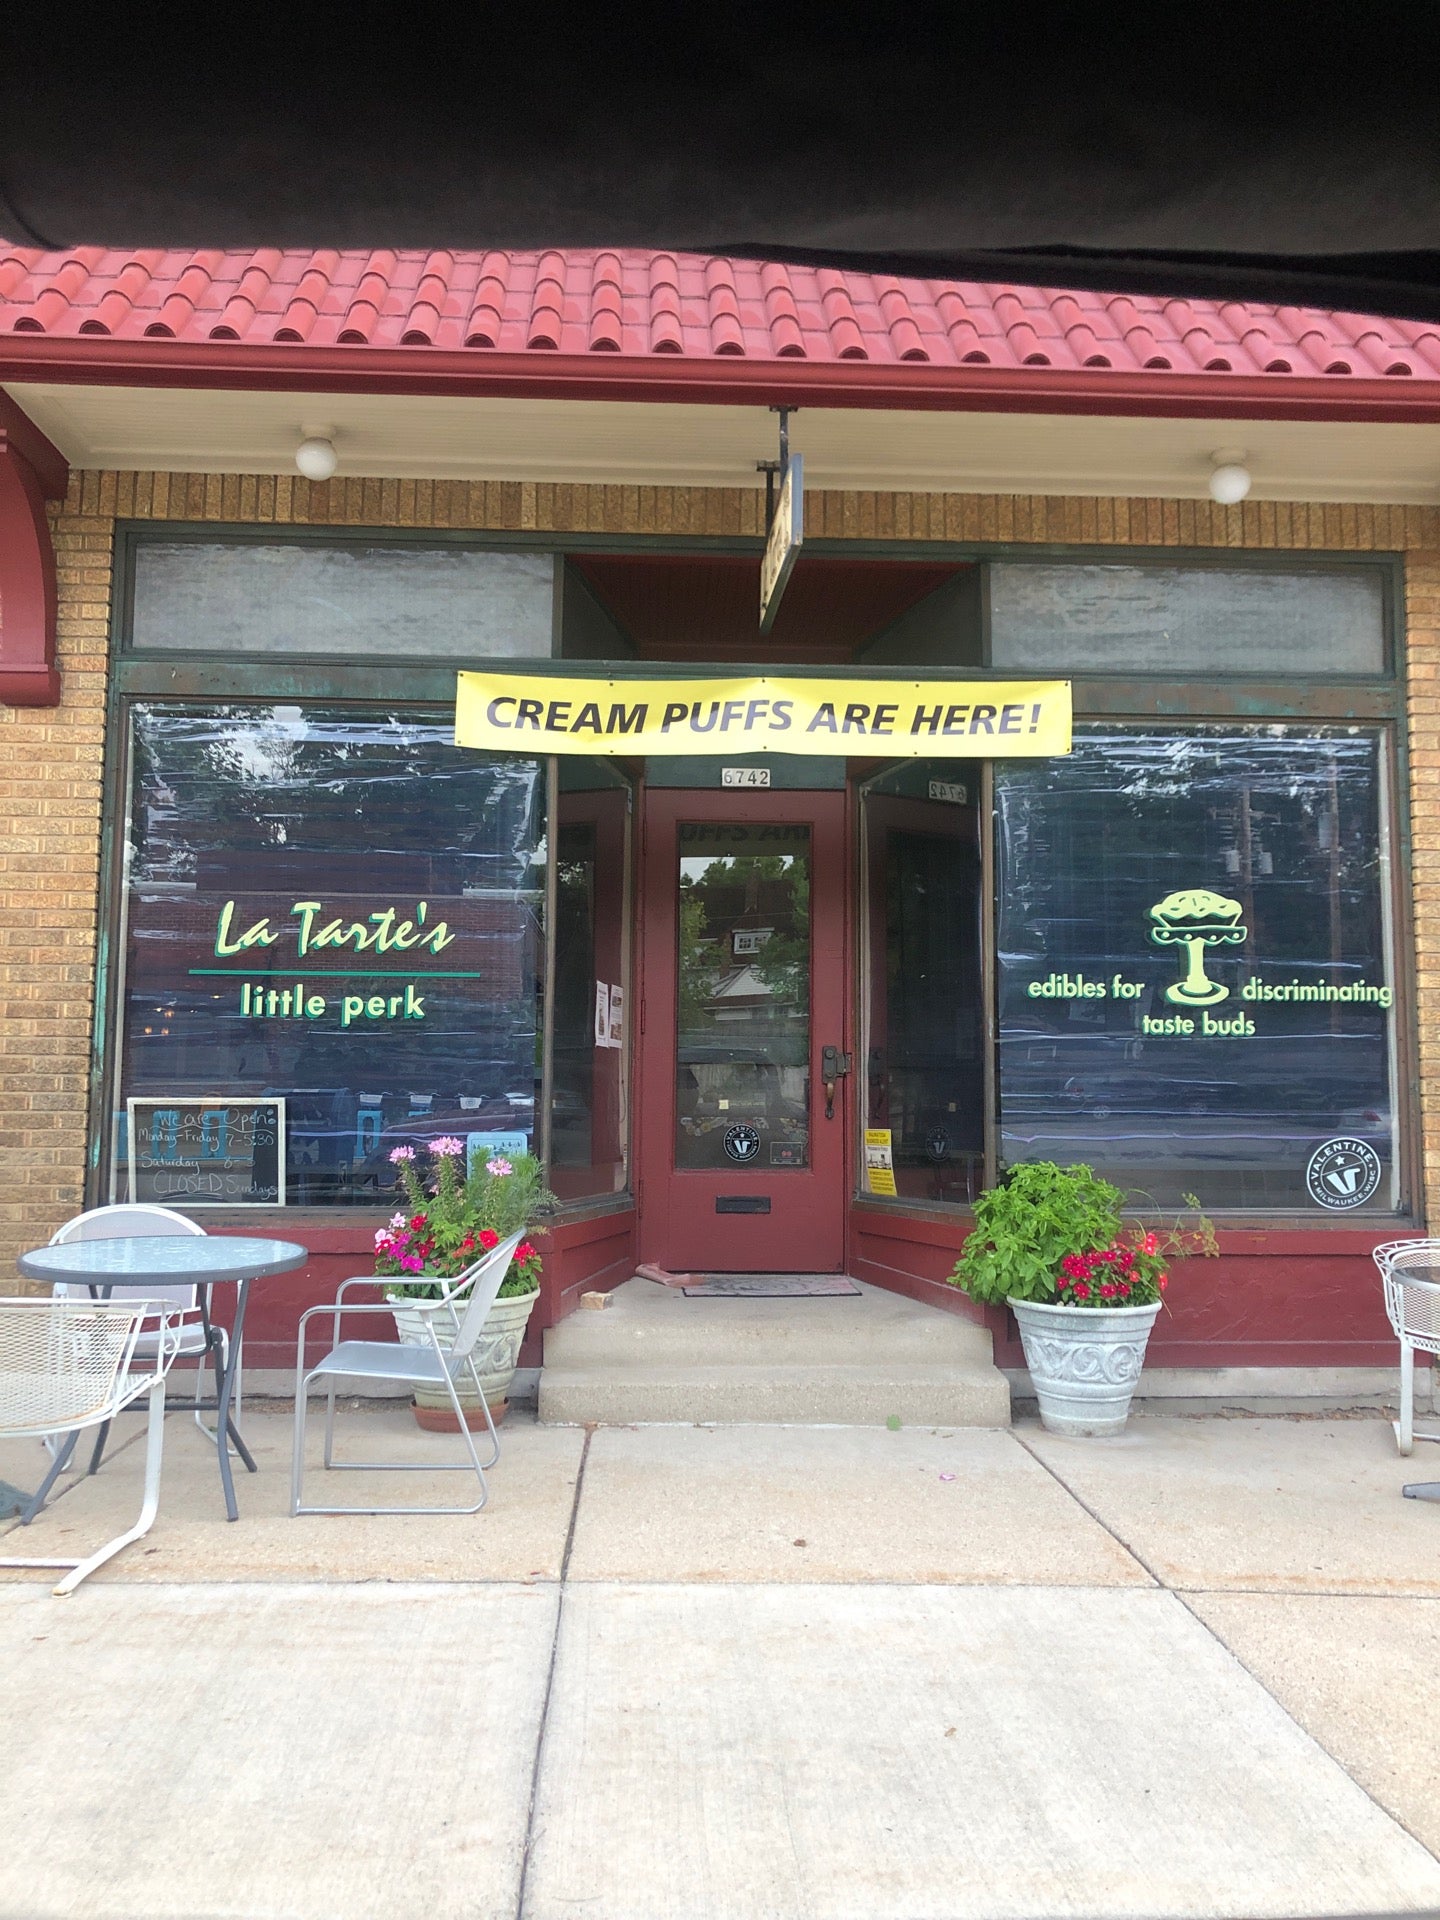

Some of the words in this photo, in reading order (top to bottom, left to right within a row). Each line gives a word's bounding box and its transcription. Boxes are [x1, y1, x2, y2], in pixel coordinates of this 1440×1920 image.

[485, 696, 648, 735] CREAM
[661, 699, 794, 735] PUFFS
[806, 703, 899, 736] ARE
[910, 703, 1042, 736] HERE!
[723, 769, 769, 786] 6742
[214, 900, 279, 957] La
[290, 901, 456, 957] Tarte's
[240, 982, 326, 1018] little
[341, 984, 425, 1027] perk
[1027, 973, 1106, 999] edibles
[1112, 974, 1145, 999] for
[1242, 976, 1393, 1008] discriminating
[1142, 1014, 1195, 1035] taste
[1202, 1011, 1256, 1036] buds
[159, 1109, 179, 1126] We
[184, 1113, 215, 1127] are
[726, 1126, 758, 1141] VALENTINE
[141, 1150, 201, 1175] Saturday
[1311, 1141, 1374, 1180] VALENTINE
[153, 1170, 223, 1194] CLOSED
[226, 1174, 278, 1200] Sundays
